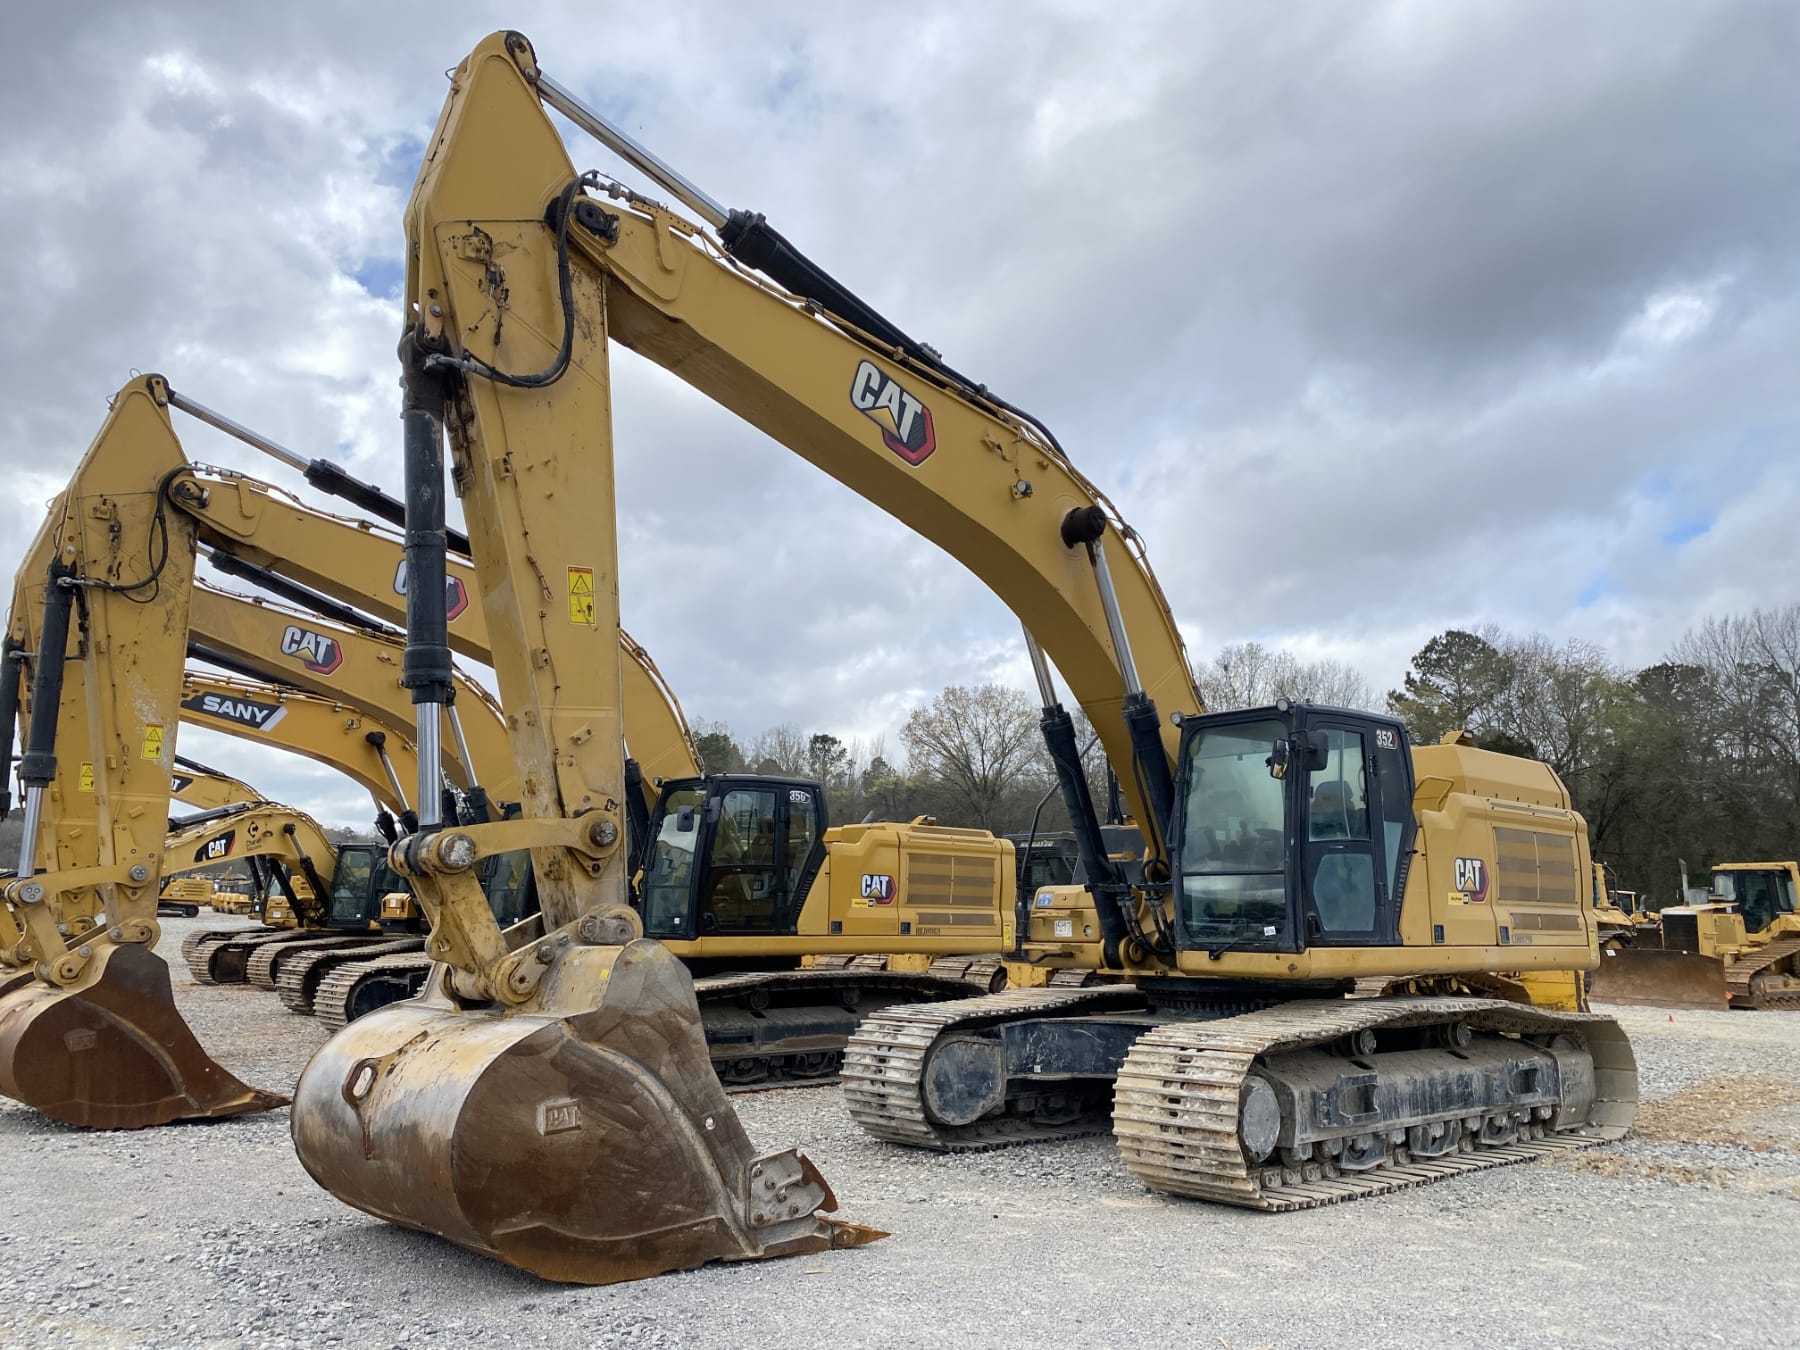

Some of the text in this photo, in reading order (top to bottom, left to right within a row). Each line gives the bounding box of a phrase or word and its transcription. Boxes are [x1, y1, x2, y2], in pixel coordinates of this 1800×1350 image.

[852, 361, 923, 444] CAT
[281, 626, 333, 665] CAT
[202, 695, 269, 723] SANY
[1376, 729, 1393, 747] 352
[208, 839, 226, 858] CAT
[861, 874, 889, 898] CAT
[1455, 858, 1481, 892] CAT
[547, 1105, 578, 1129] CAT
